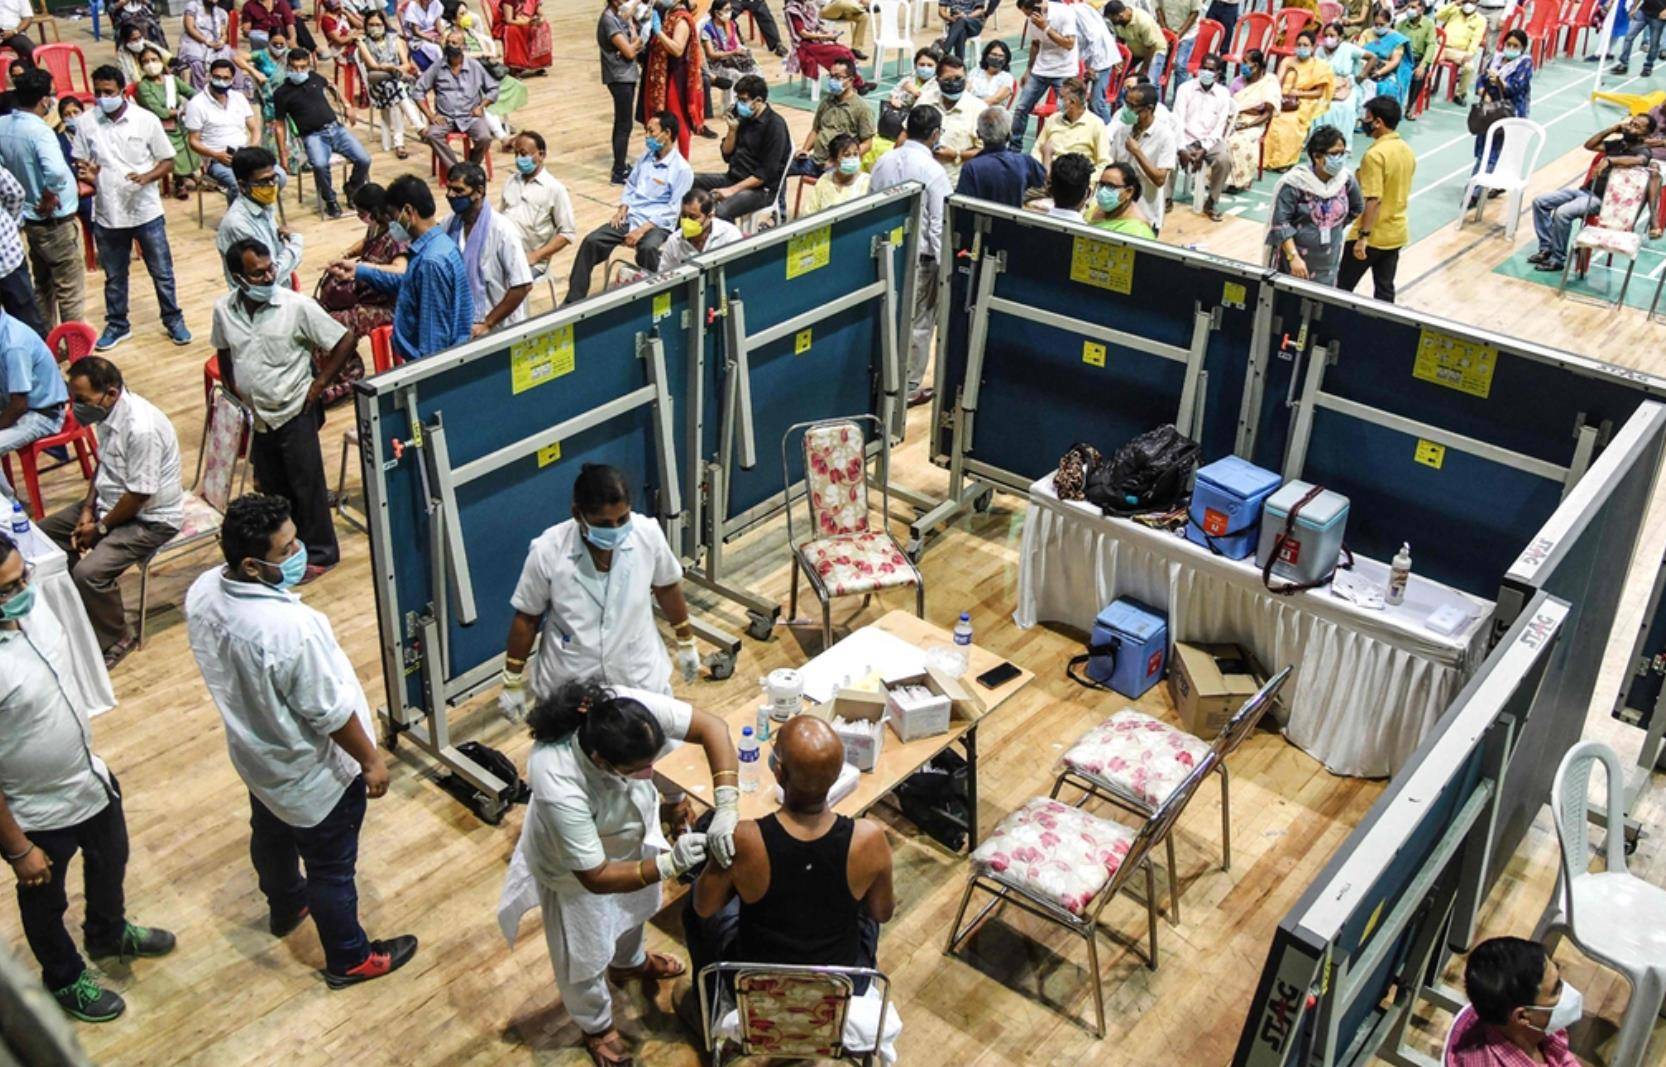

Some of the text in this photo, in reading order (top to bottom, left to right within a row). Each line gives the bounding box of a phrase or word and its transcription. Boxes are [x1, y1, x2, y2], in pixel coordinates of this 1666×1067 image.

[360, 420, 375, 469] STAG
[1521, 538, 1555, 566] STAG
[1520, 614, 1554, 648] STAG
[1261, 981, 1301, 1053] STAG
